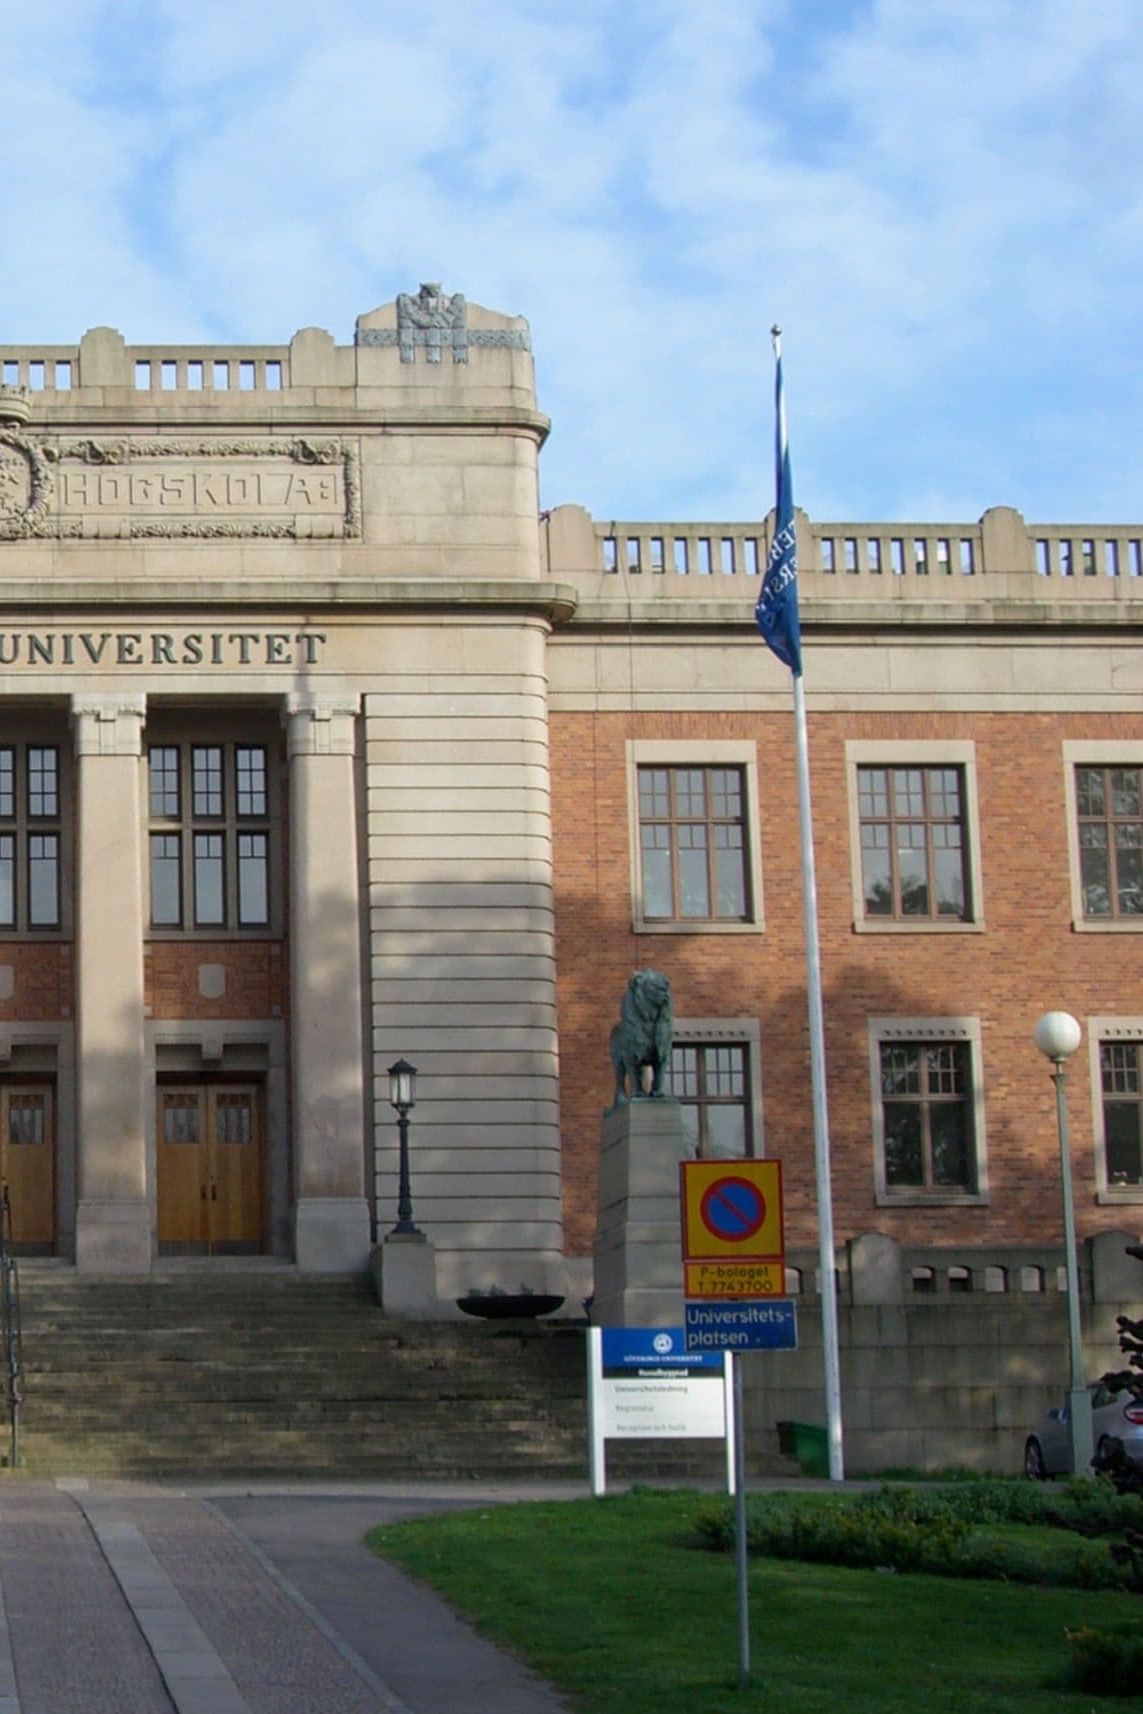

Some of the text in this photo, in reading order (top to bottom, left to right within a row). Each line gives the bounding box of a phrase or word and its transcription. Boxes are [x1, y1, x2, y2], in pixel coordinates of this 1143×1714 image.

[700, 1266, 769, 1279] P-bolaget
[687, 1308, 792, 1325] Universitets-
[688, 1331, 749, 1348] platsen
